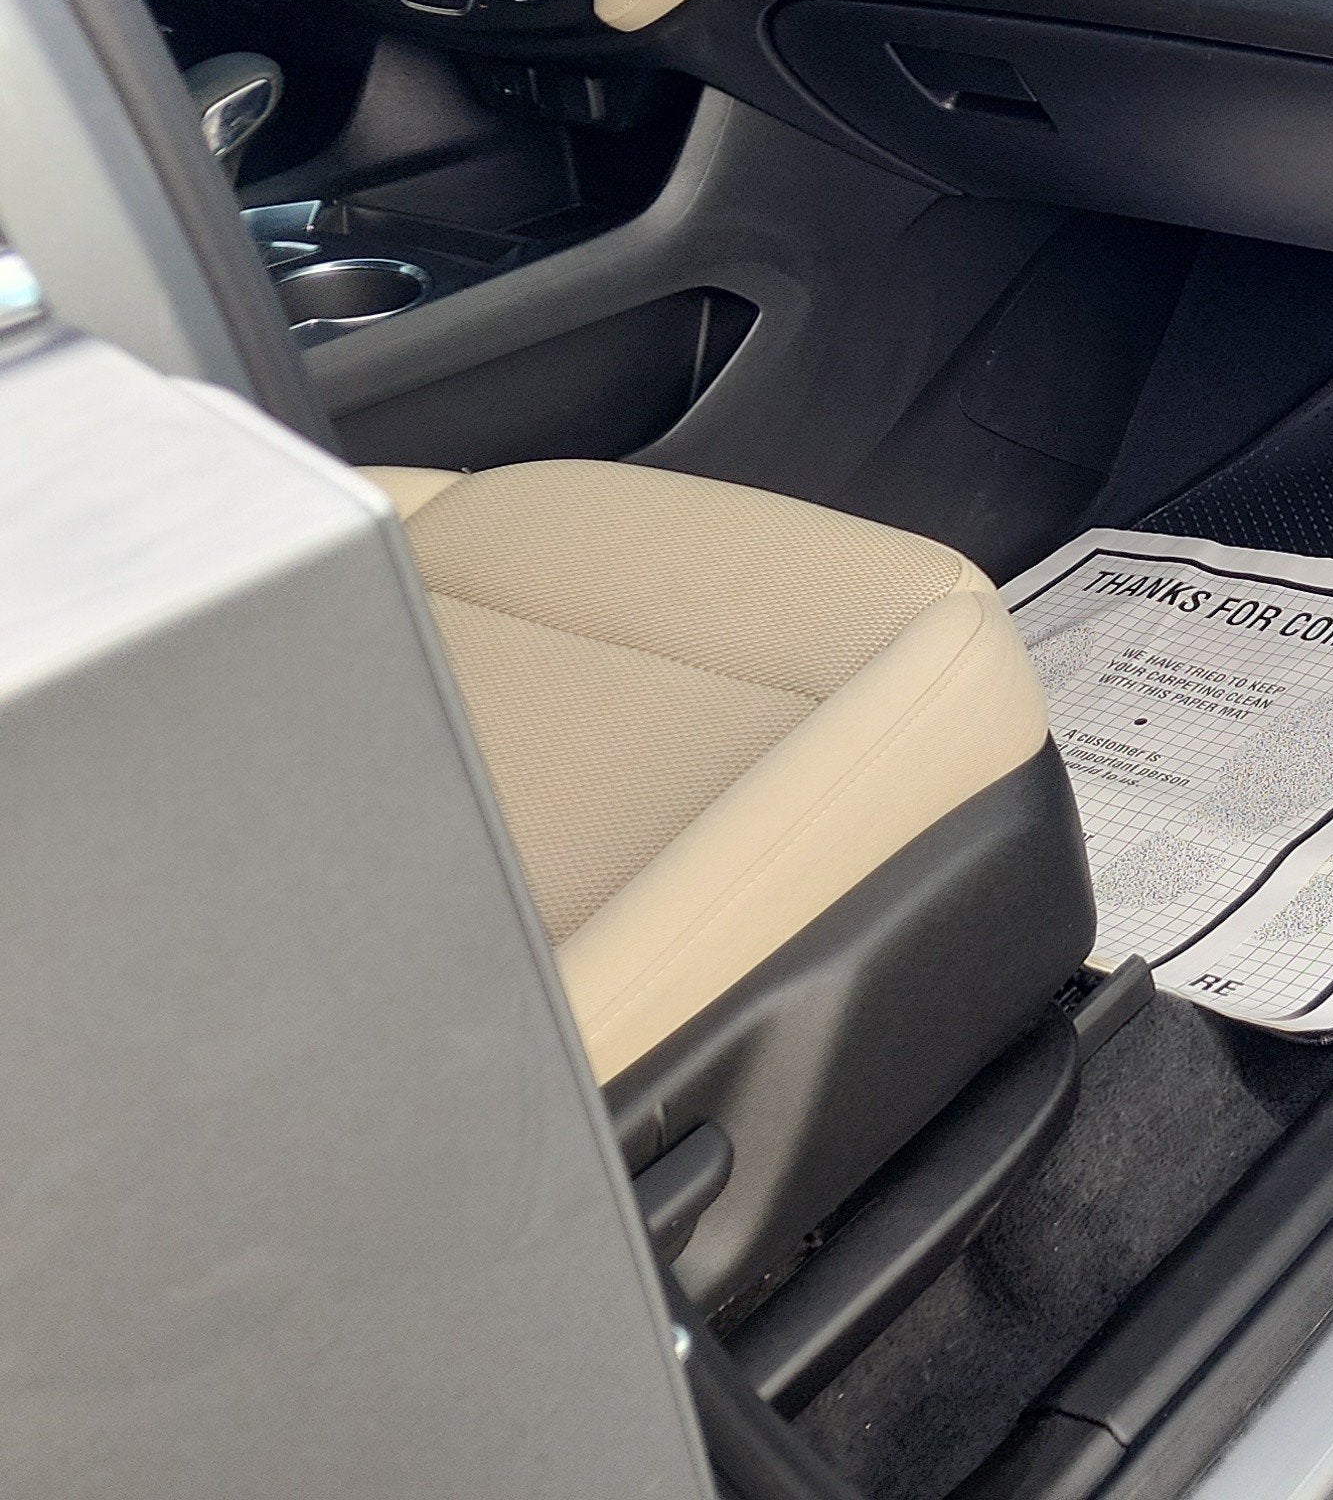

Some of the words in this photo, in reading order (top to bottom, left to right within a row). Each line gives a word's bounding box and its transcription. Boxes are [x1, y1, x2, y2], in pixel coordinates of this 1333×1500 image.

[1082, 570, 1212, 613] THANKS
[1205, 596, 1282, 632] FOR
[1106, 659, 1146, 678] YOUR
[1146, 671, 1226, 699] CARPETING
[1224, 691, 1274, 710] CLEAN
[1122, 647, 1147, 661] WE
[1145, 653, 1185, 672] HAVE
[1182, 664, 1227, 684] TRIED
[1225, 676, 1248, 688] TO
[1247, 680, 1287, 696] KEEP
[1098, 673, 1138, 690] WITH
[1136, 683, 1174, 700] THIS
[1170, 693, 1219, 713] PAPER
[1217, 706, 1252, 720] MAT
[1062, 729, 1078, 740] A
[1076, 732, 1146, 758] customer
[1145, 751, 1161, 762] is
[1066, 746, 1140, 773] important
[1135, 767, 1191, 787] person
[1101, 770, 1118, 781] to
[1118, 776, 1140, 788] us.
[1188, 973, 1245, 997] RE
